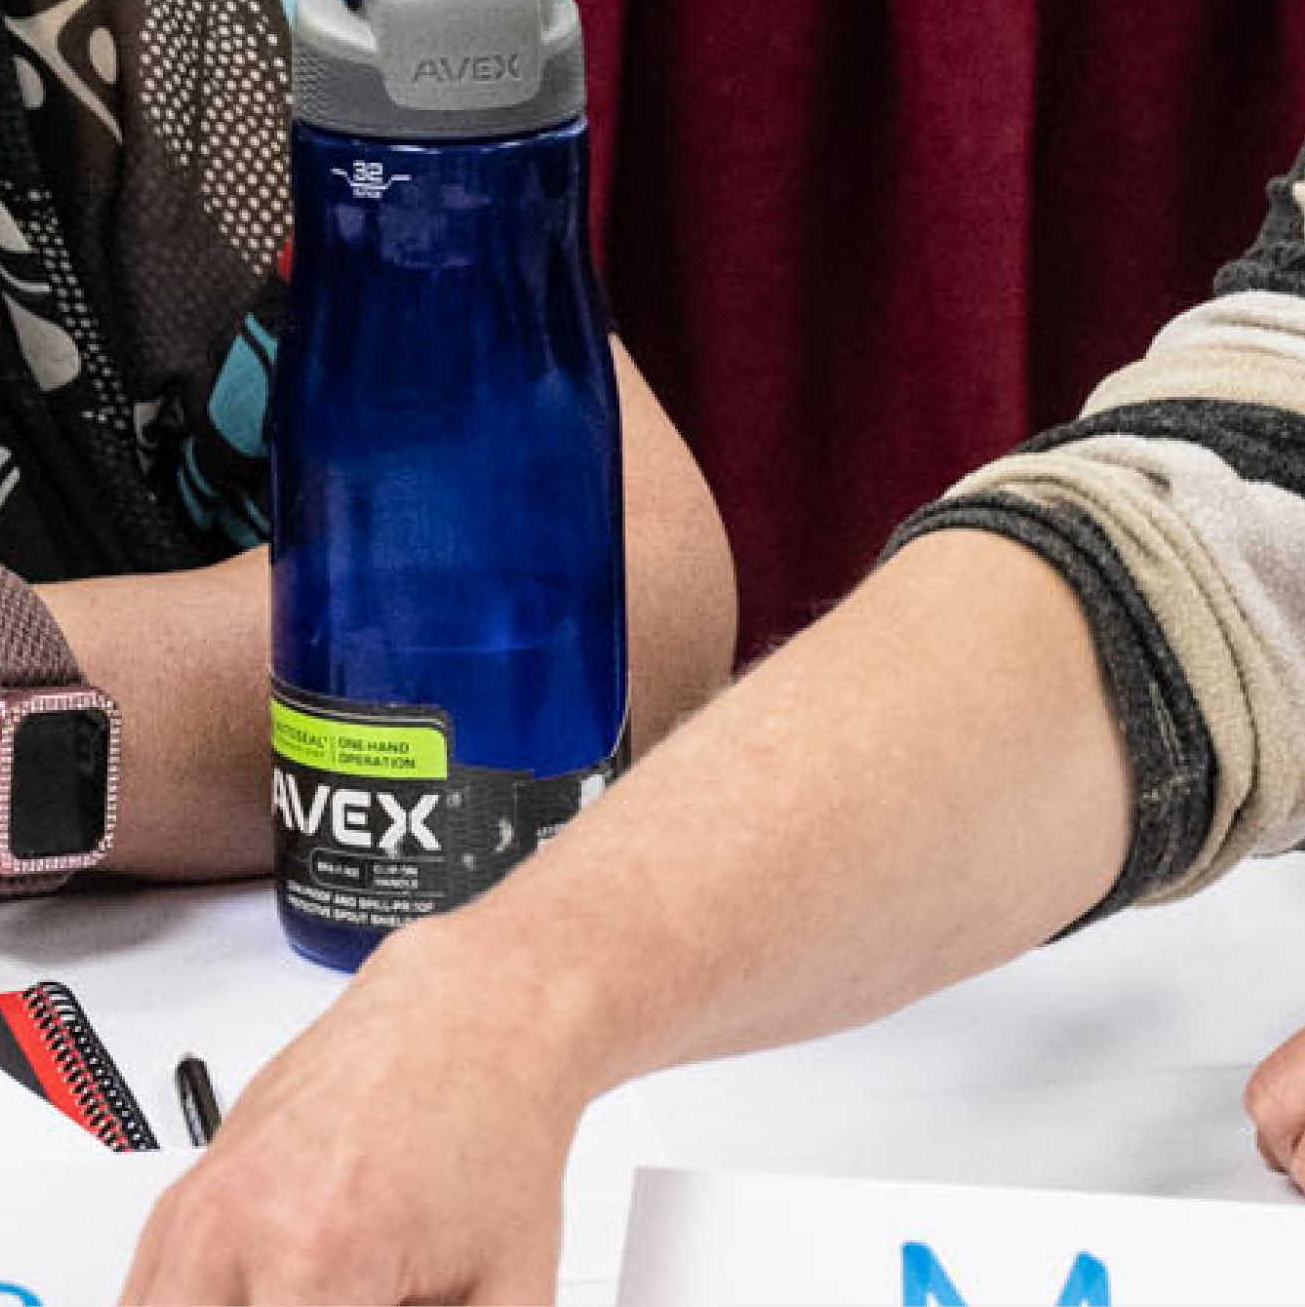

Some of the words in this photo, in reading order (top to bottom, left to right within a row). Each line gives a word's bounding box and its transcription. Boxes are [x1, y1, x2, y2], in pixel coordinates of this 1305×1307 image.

[412, 53, 519, 83] AVEX
[353, 160, 383, 183] 32
[367, 741, 410, 755] HAND
[339, 754, 416, 769] OPERATION
[272, 769, 441, 852] AVEX
